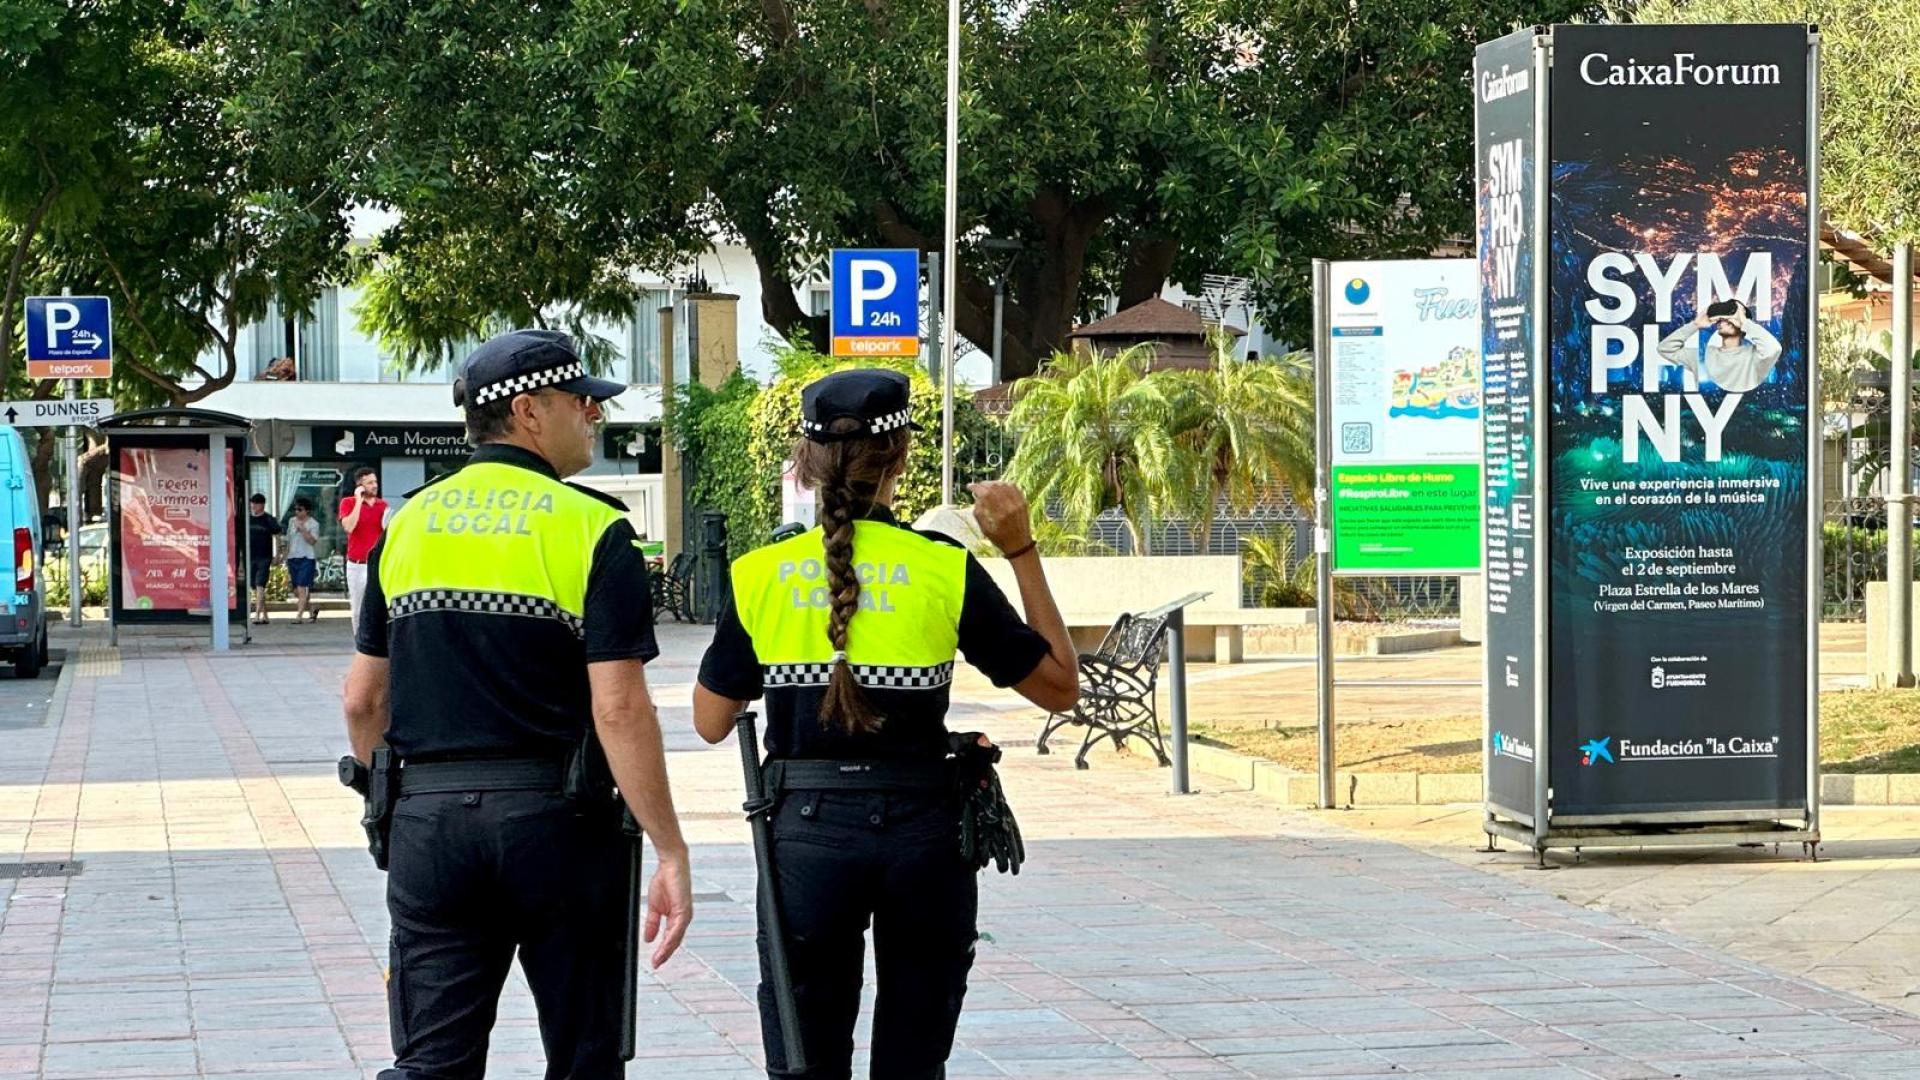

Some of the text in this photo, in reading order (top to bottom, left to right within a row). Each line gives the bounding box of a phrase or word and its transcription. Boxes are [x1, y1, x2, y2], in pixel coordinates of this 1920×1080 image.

[1579, 52, 1781, 86] CaixaForum
[1481, 64, 1529, 103] CaixaForum
[1488, 138, 1523, 198] SYM
[1491, 191, 1523, 248] PHO
[1496, 244, 1518, 300] NY
[848, 259, 897, 327] P
[1584, 251, 1772, 324] SYM
[45, 302, 80, 349] P
[870, 311, 901, 327] 24h
[71, 329, 91, 339] 24h
[850, 340, 902, 353] telpark
[48, 364, 94, 376] telpark
[35, 402, 100, 417] DUNNES
[1622, 393, 1744, 463] NY
[365, 431, 467, 446] Ana Moreno
[405, 447, 466, 456] decoración
[1379, 473, 1405, 482] Libre
[1407, 473, 1421, 482] de
[1423, 473, 1454, 482] Humo
[1580, 476, 1780, 492] Vive una experiencia inmersiva
[421, 488, 554, 513] POLICIA
[1426, 489, 1448, 498] este
[1450, 488, 1477, 500] lugar
[1595, 491, 1765, 505] en el corazón de la música
[426, 512, 533, 536] LOCAL
[1625, 546, 1734, 561] Exposición hasta
[779, 558, 911, 586] POCIA
[1622, 562, 1737, 577] el 2 de septiembre
[1599, 582, 1760, 597] Plaza Estrella de los Mares
[793, 587, 896, 612] LOAL
[1593, 597, 1765, 613] (Virgen del Carmen, Paseo Marítimo)
[1620, 738, 1704, 757] Fundación
